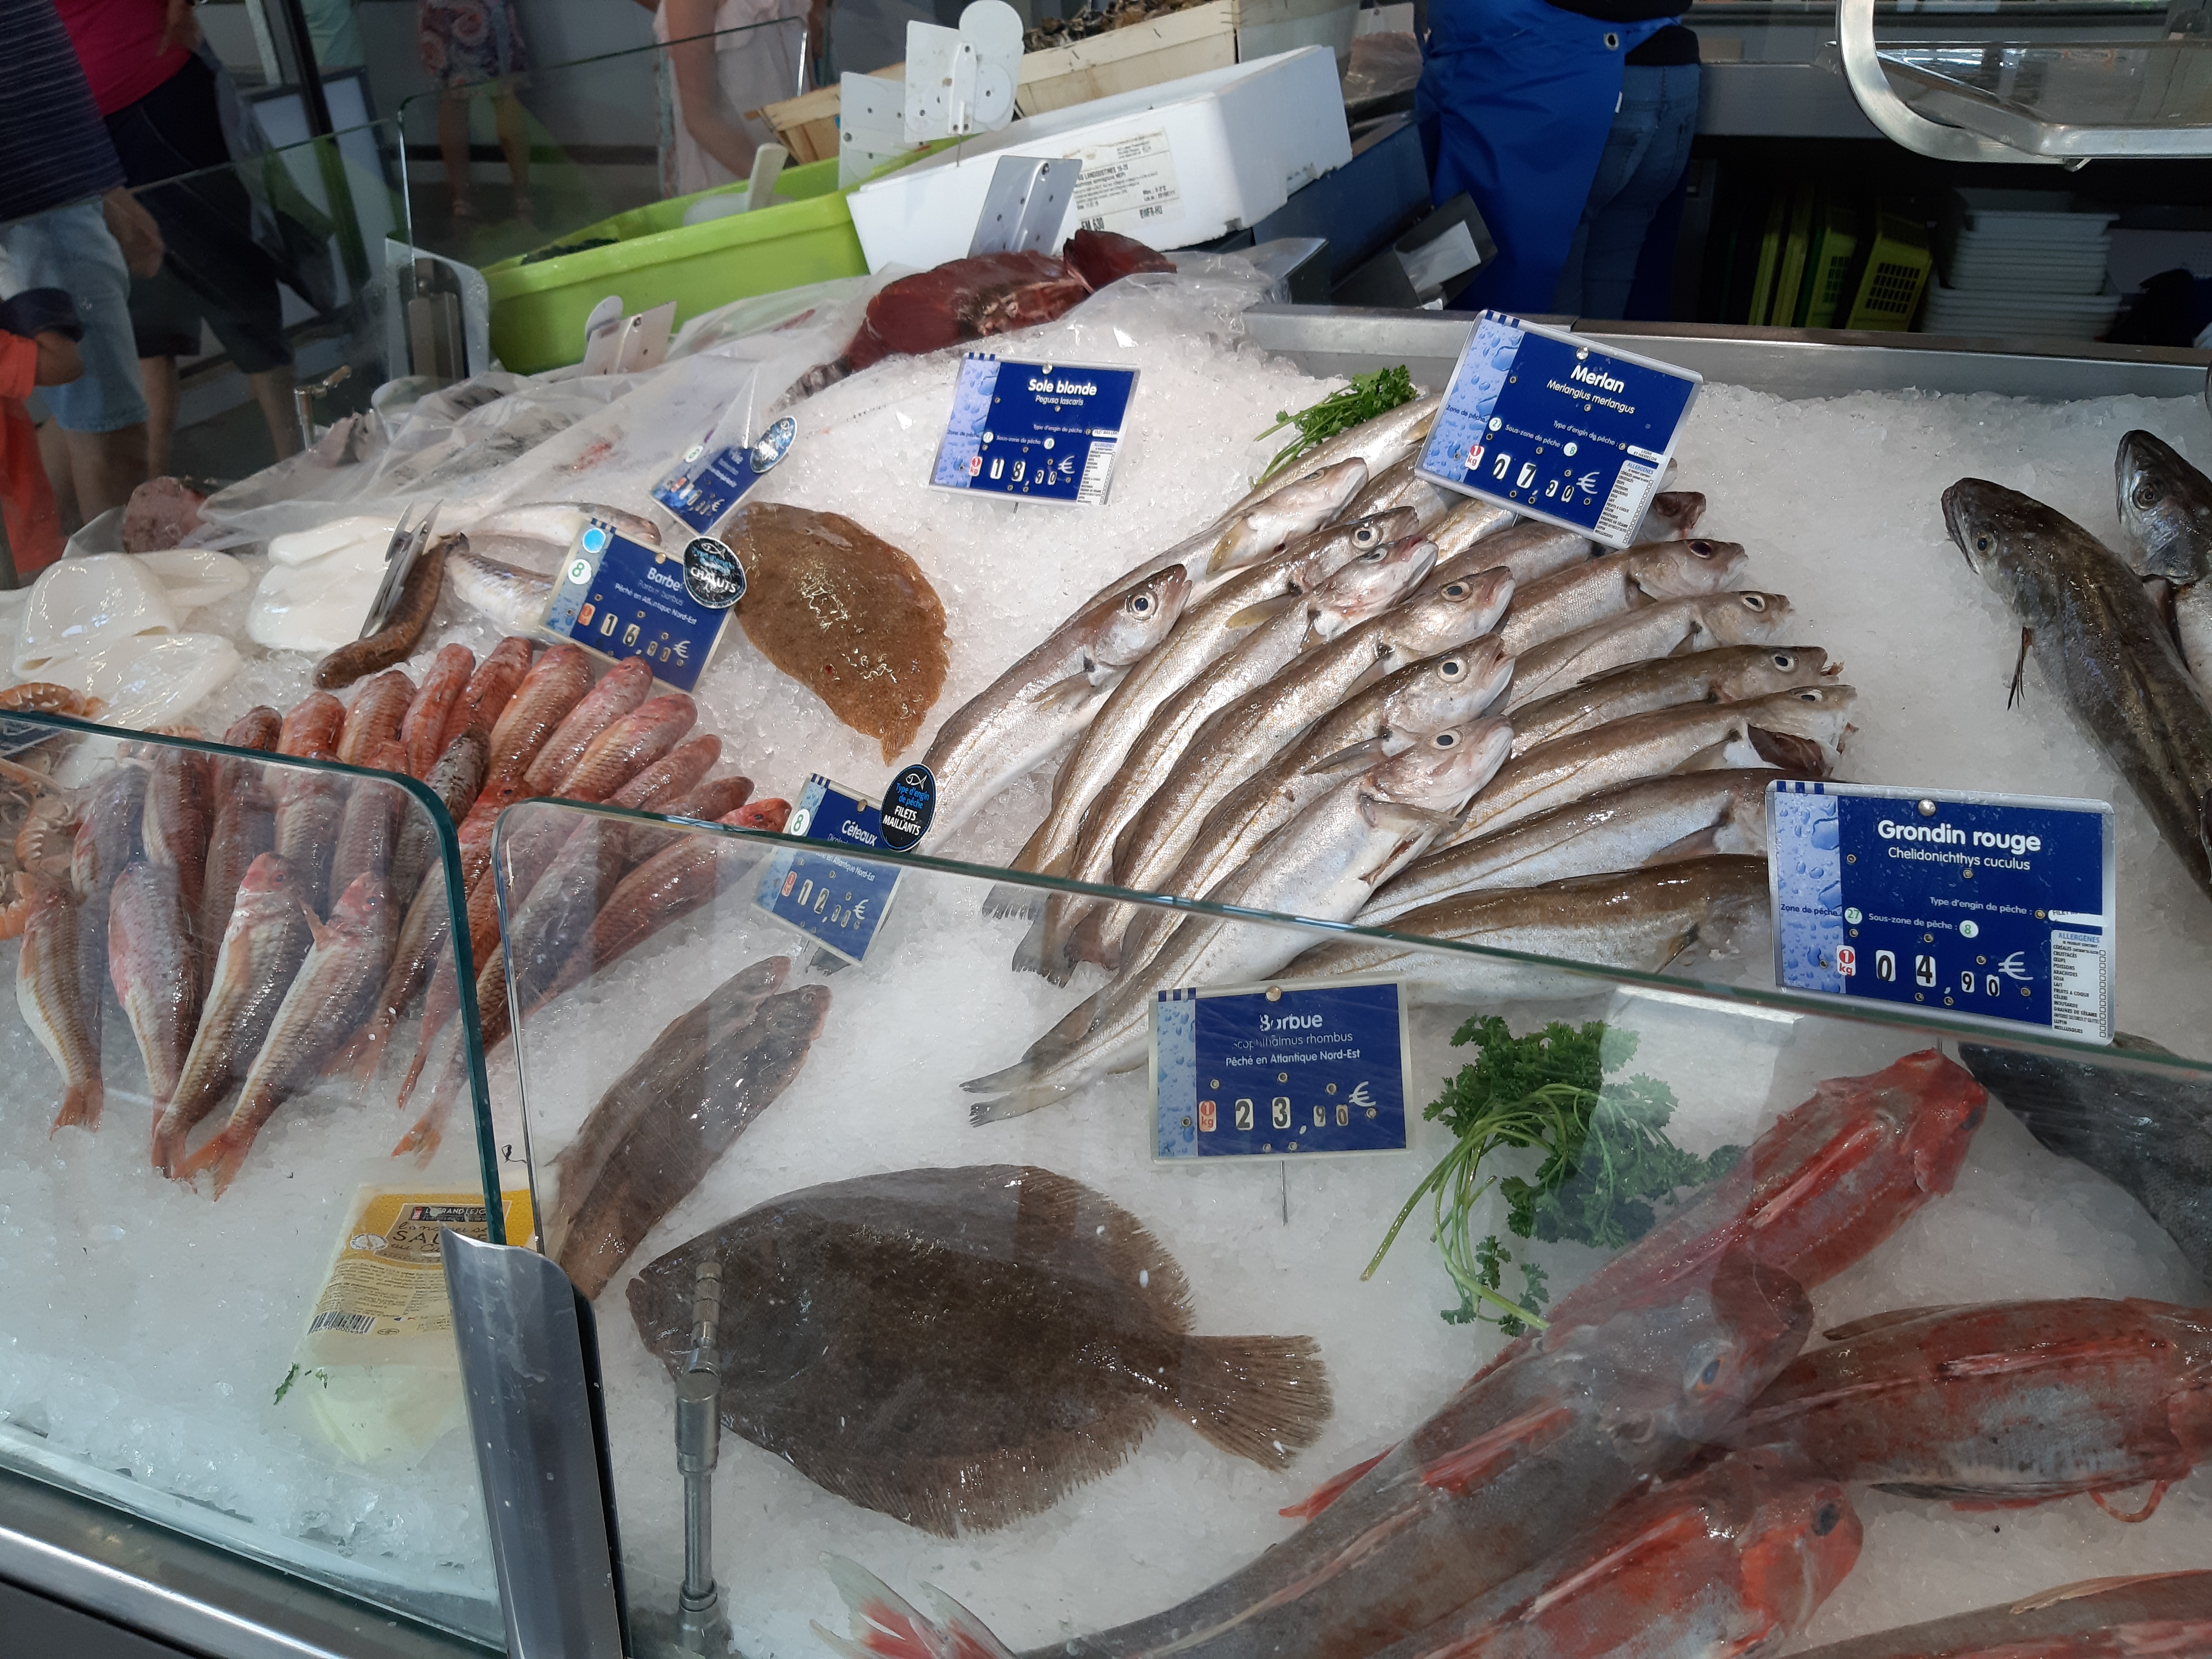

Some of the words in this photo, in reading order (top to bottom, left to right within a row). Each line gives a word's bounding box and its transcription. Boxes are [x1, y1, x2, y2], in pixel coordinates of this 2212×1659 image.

[1028, 378, 1054, 392] Sole
[1056, 380, 1097, 396] blonde
[1571, 365, 1625, 393] Merlan
[1035, 395, 1059, 405] Pegusa
[1060, 397, 1083, 406] lascaris
[1547, 379, 1591, 401] Merlangius
[1591, 395, 1635, 414] merlangus
[1446, 405, 1460, 414] Zone
[1492, 419, 1502, 428] 27
[984, 432, 992, 440] 27
[1505, 424, 1534, 439] Sous-zone
[1543, 437, 1561, 448] pêche
[1553, 420, 1566, 430] Type
[1567, 425, 1588, 439] d'engin
[1589, 432, 1597, 441] de
[1597, 434, 1615, 446] pêche
[1570, 446, 1576, 455] 8
[1057, 455, 1075, 474] €
[1467, 456, 1477, 466] kg
[1576, 471, 1600, 494] €
[572, 562, 585, 578] 8
[647, 567, 684, 592] Barbe
[673, 640, 691, 659] €
[896, 782, 909, 794] Type
[909, 787, 929, 801] d'engin
[899, 794, 906, 803] de
[906, 797, 923, 809] pêche
[894, 805, 917, 821] FILETS
[793, 814, 804, 832] 8
[883, 815, 921, 836] MAILLANTS
[842, 820, 878, 847] Céteaux
[1878, 820, 1966, 845] Grondin
[1973, 831, 2041, 855] rouge
[1888, 847, 1980, 868] Chelidonichthys
[1984, 857, 2031, 871] cuculus
[833, 856, 856, 872] Atlantique
[855, 866, 875, 881] Nord-Est
[853, 899, 869, 920] €
[1780, 903, 1800, 912] Zone
[1802, 905, 1812, 913] de
[1814, 905, 1838, 916] pêche
[1847, 909, 1861, 919] 27
[1929, 897, 1949, 906] Type
[1951, 898, 1984, 910] d'engin
[1986, 903, 1998, 911] de
[2000, 904, 2027, 915] pêche
[1869, 913, 1912, 925] Sous-zone
[1913, 918, 1925, 926] de
[1927, 919, 1952, 930] pêche
[1965, 924, 1972, 935] 8
[2058, 932, 2100, 943] ALLERGÈNES
[1839, 963, 1853, 976] kg
[1997, 951, 2034, 980] €
[1306, 1031, 1354, 1045] rhombus
[1226, 1055, 1253, 1067] Pêché
[1256, 1057, 1268, 1065] en
[1270, 1052, 1318, 1064] Atlantique
[1320, 1049, 1361, 1061] Nord-Est
[1348, 1081, 1377, 1107] €
[1201, 1115, 1214, 1128] kg
